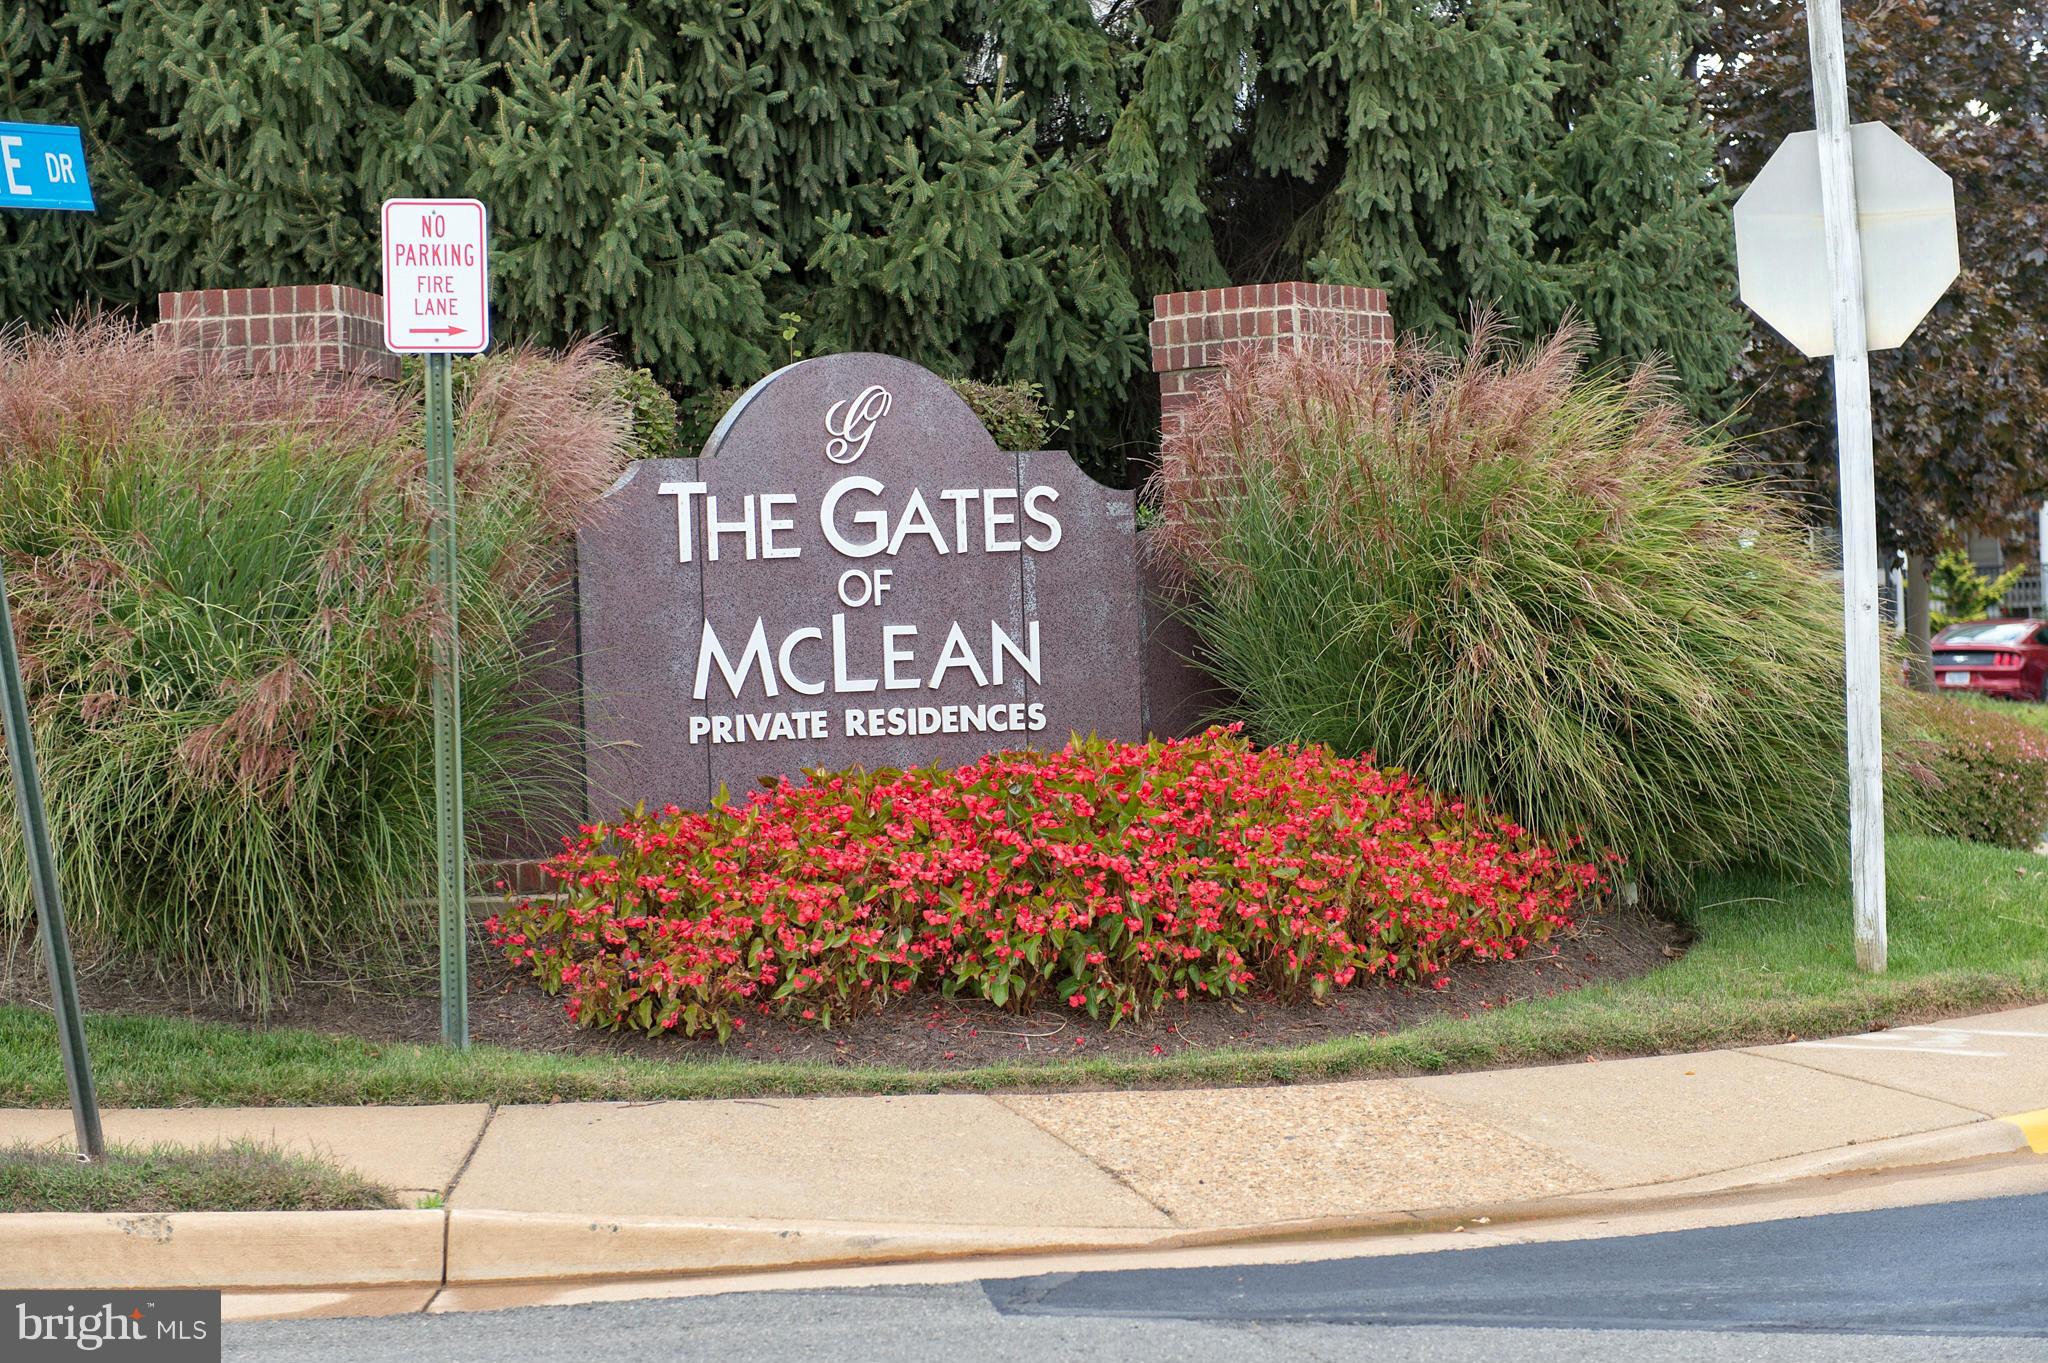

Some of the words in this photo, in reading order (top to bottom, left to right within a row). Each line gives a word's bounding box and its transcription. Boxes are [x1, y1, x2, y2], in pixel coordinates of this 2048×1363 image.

[0, 135, 33, 195] E
[44, 152, 77, 184] DR
[421, 214, 446, 238] NO
[395, 243, 475, 267] PARKING
[417, 275, 455, 293] FIRE
[414, 298, 459, 316] LANE
[657, 481, 802, 563] THE
[819, 475, 1062, 558] GATES
[837, 568, 893, 608] OF
[688, 709, 829, 744] PRIVATE
[845, 702, 1047, 737] RESIDENCES
